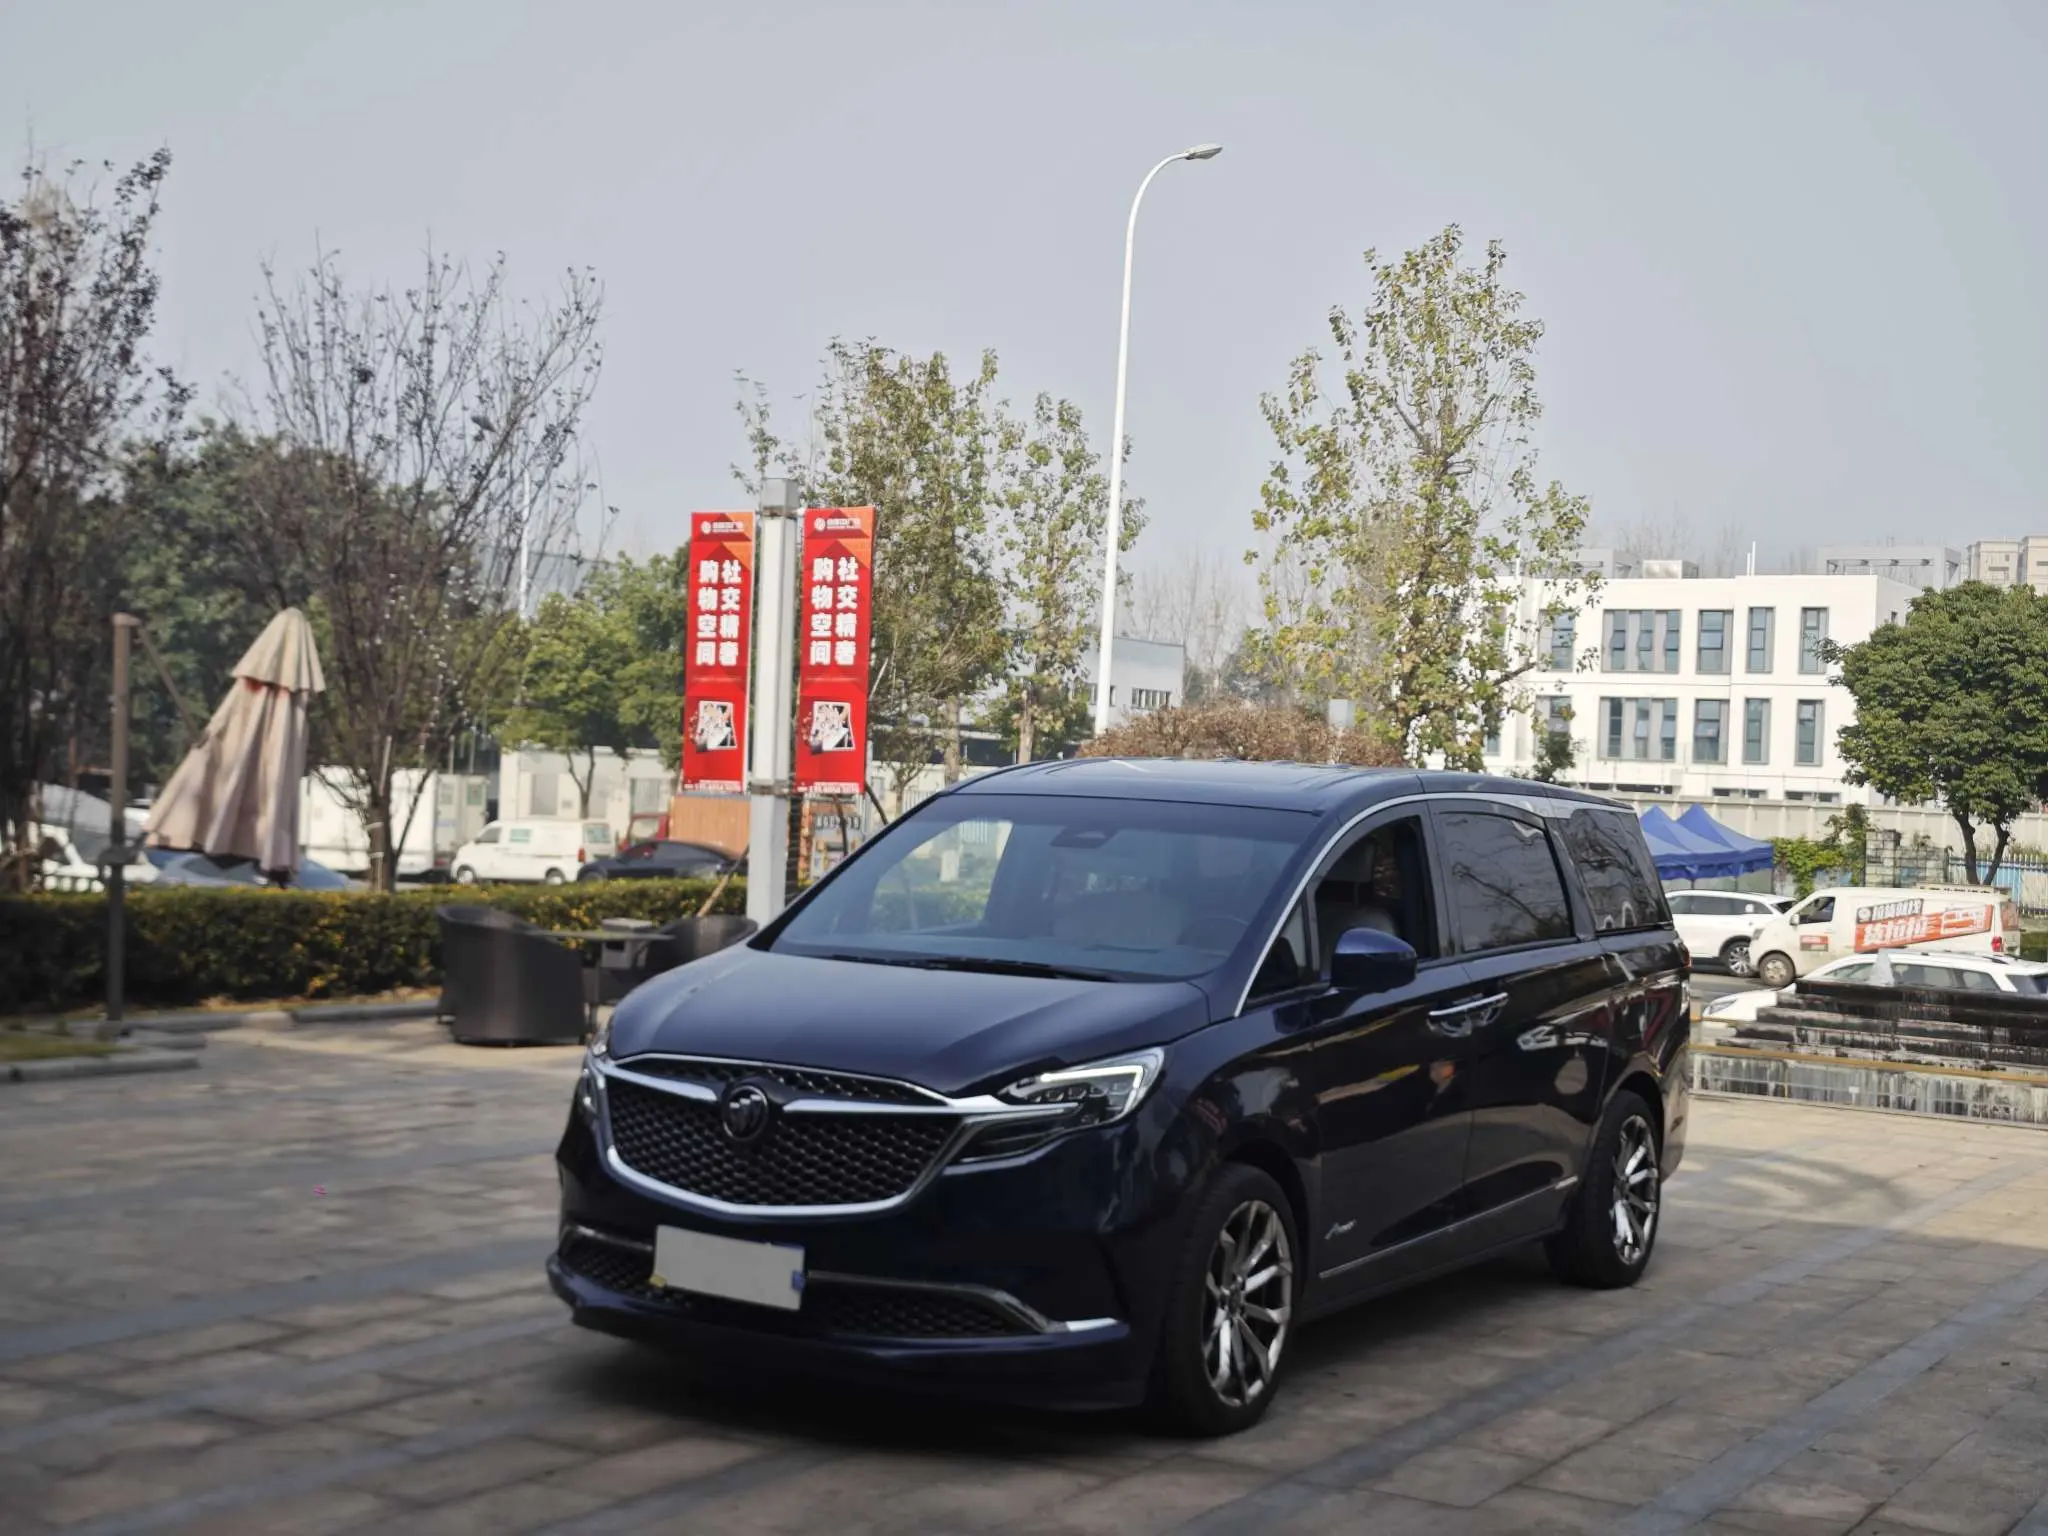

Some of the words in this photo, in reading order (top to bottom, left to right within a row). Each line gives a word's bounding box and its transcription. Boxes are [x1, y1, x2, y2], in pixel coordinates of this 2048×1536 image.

[696, 559, 719, 666] 购物空间
[809, 557, 834, 666] 购物空间
